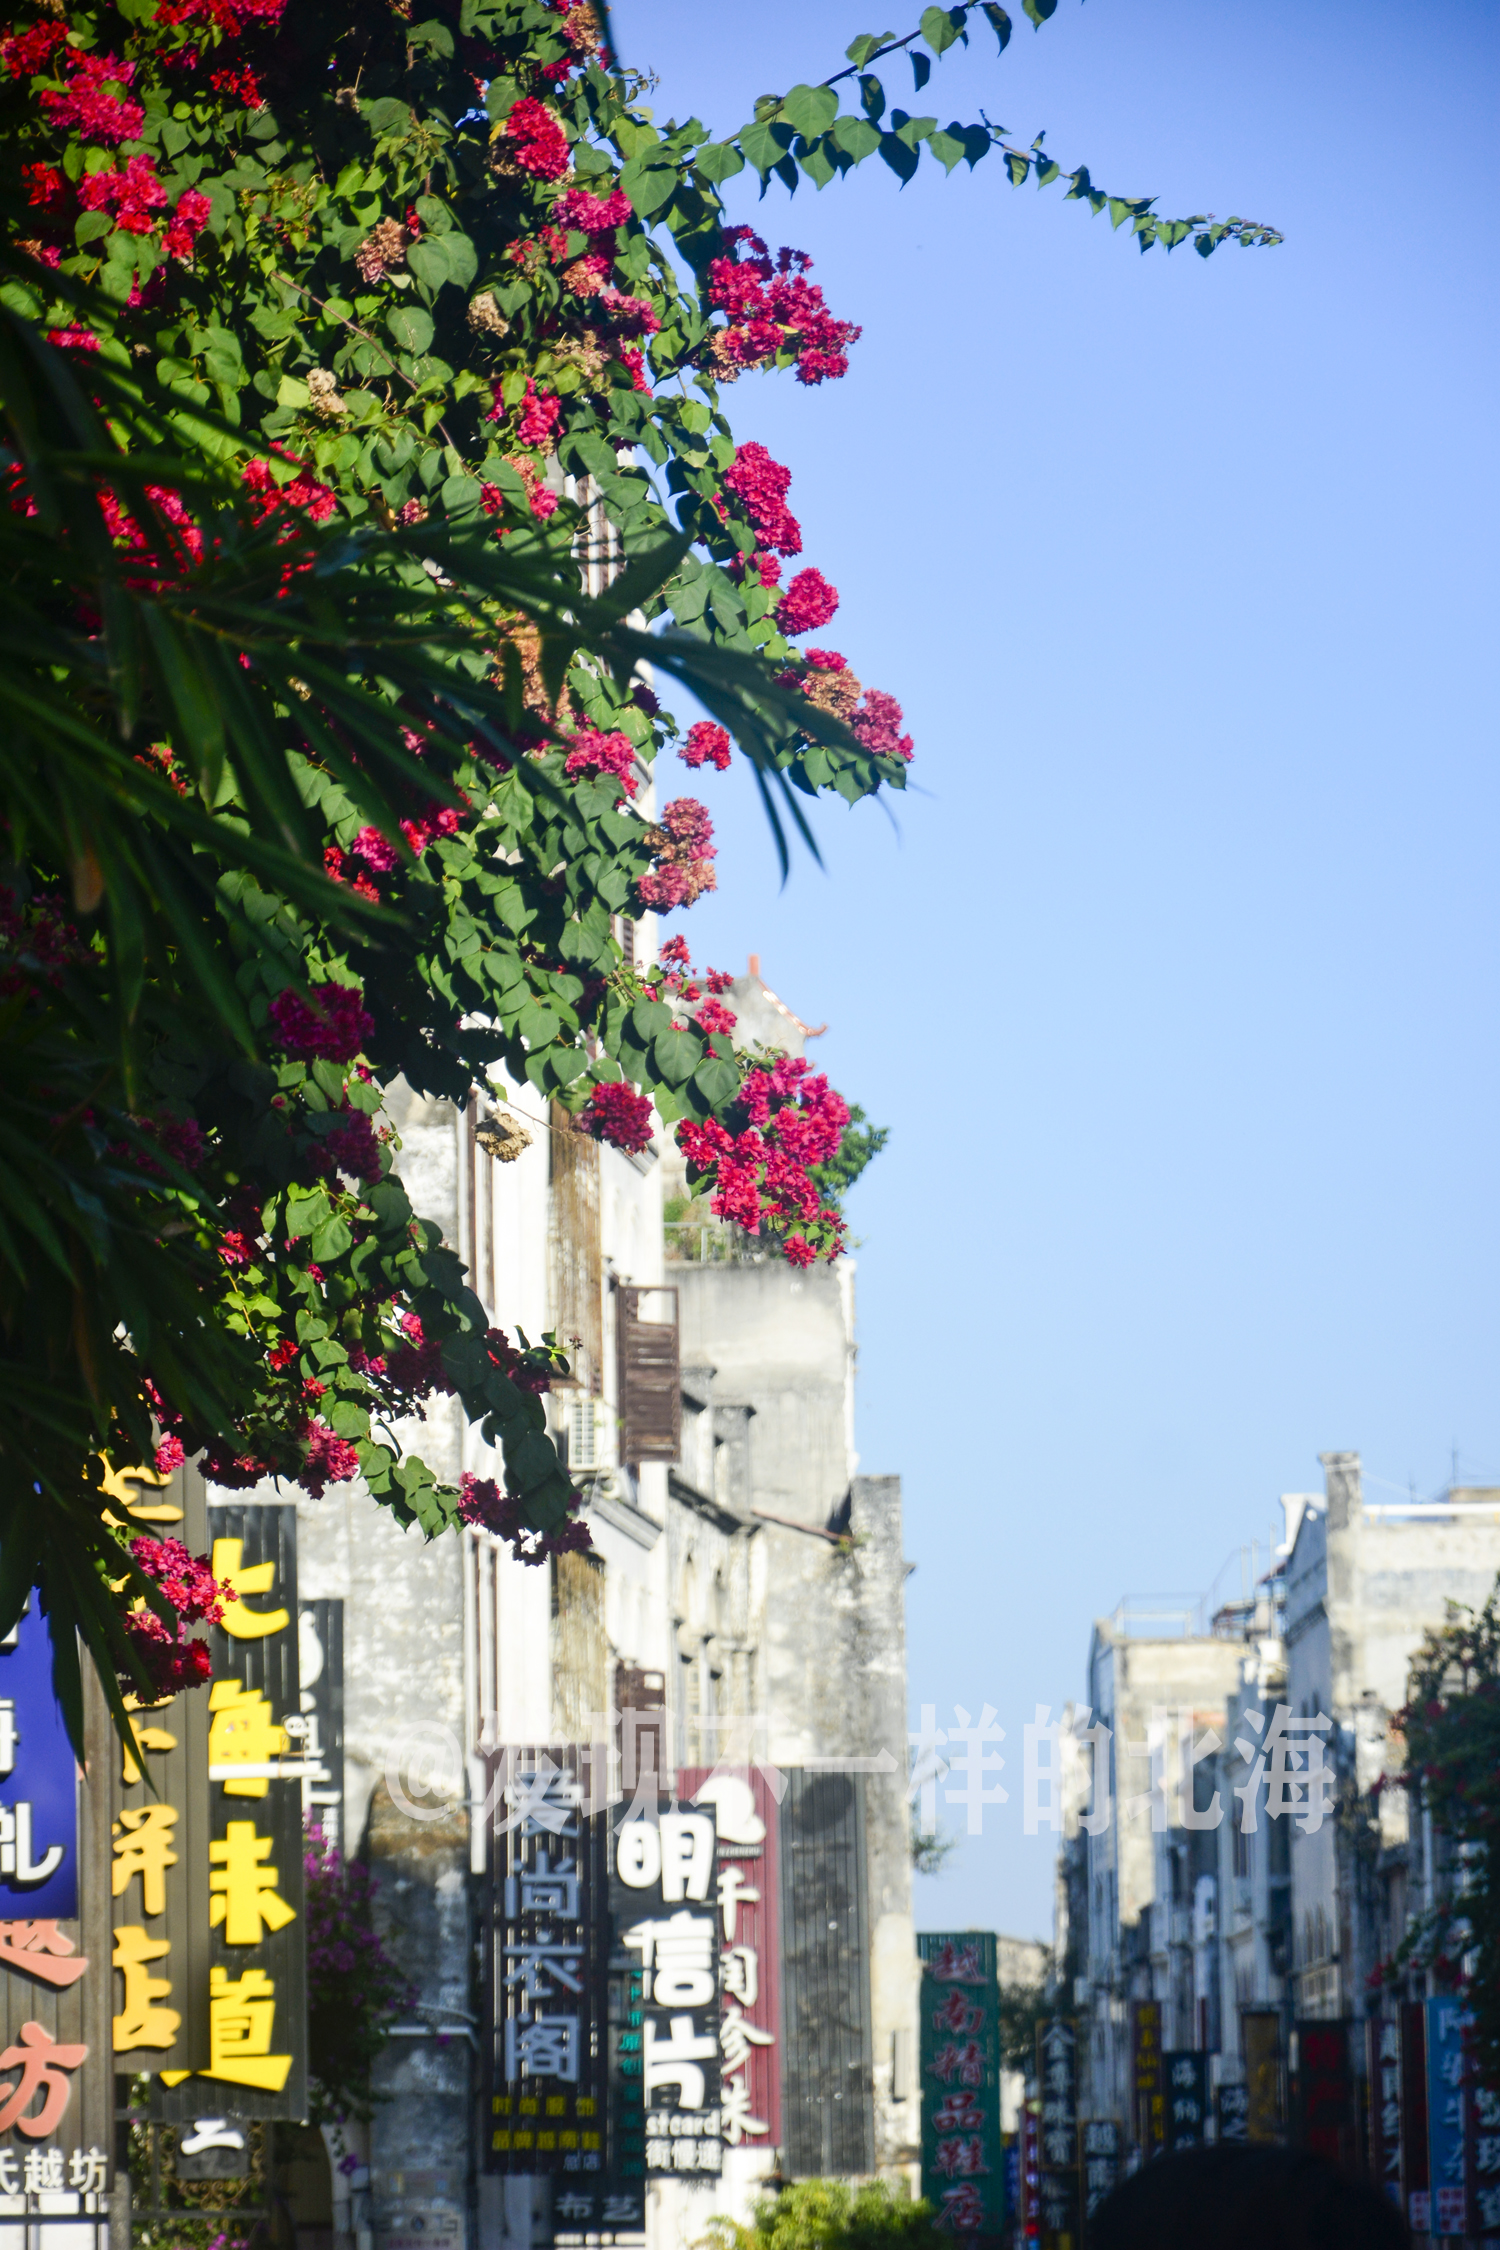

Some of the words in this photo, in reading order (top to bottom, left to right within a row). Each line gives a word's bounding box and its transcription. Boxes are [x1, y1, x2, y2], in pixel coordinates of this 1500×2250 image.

[617, 1813, 718, 2110] 明信片
[926, 1941, 991, 2230] 越南精品鞋店
